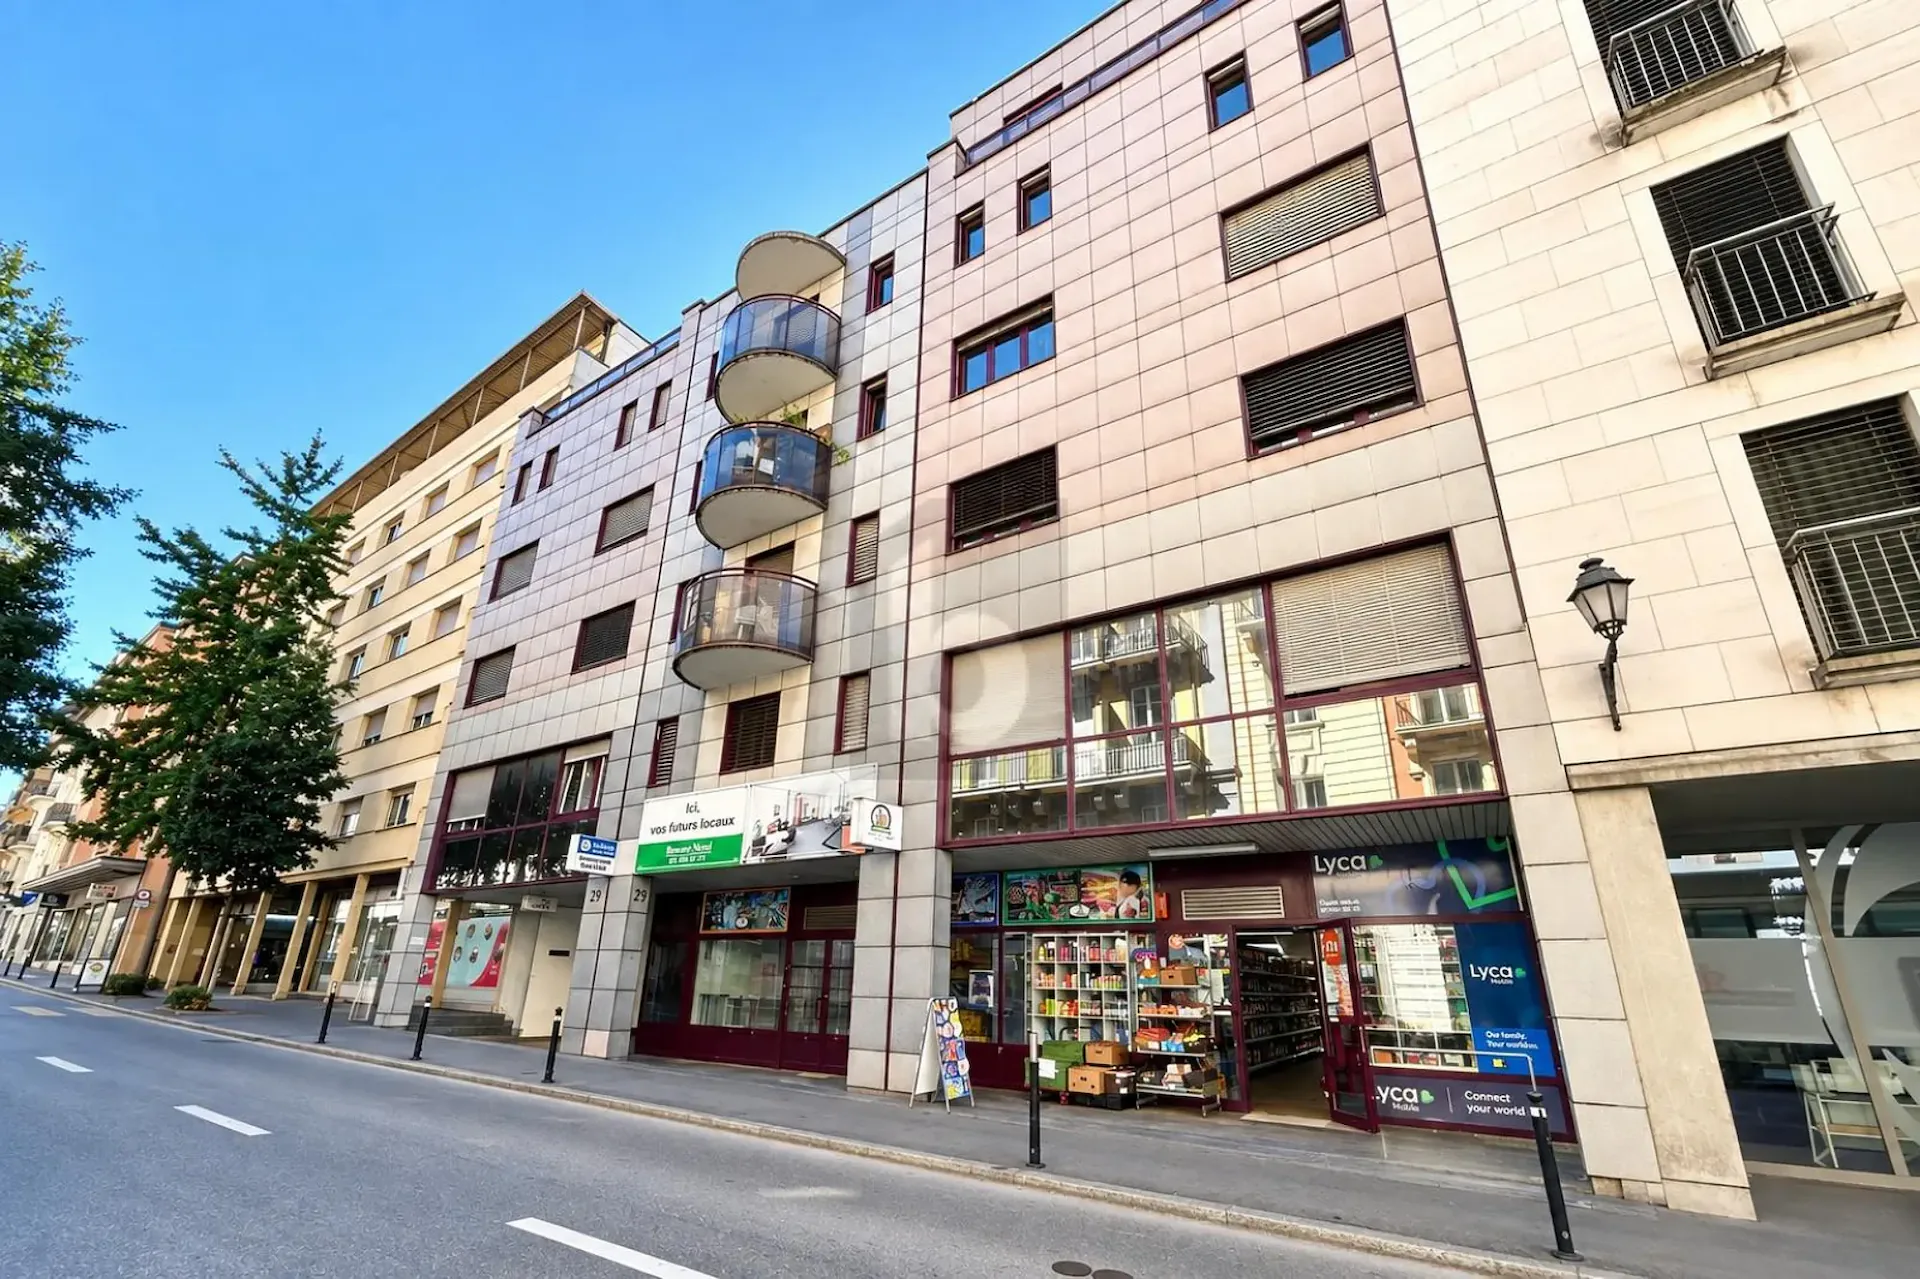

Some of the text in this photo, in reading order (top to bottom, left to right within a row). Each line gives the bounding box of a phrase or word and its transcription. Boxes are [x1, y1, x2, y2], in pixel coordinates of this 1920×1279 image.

[650, 817, 735, 836] vos futurs locaux
[1314, 854, 1367, 876] Lyca
[590, 889, 602, 902] 29
[633, 888, 647, 902] 29
[1469, 963, 1513, 981] Lyca
[1375, 1085, 1418, 1104] yca
[1464, 1090, 1511, 1103] Connect
[1466, 1103, 1526, 1116] your world
